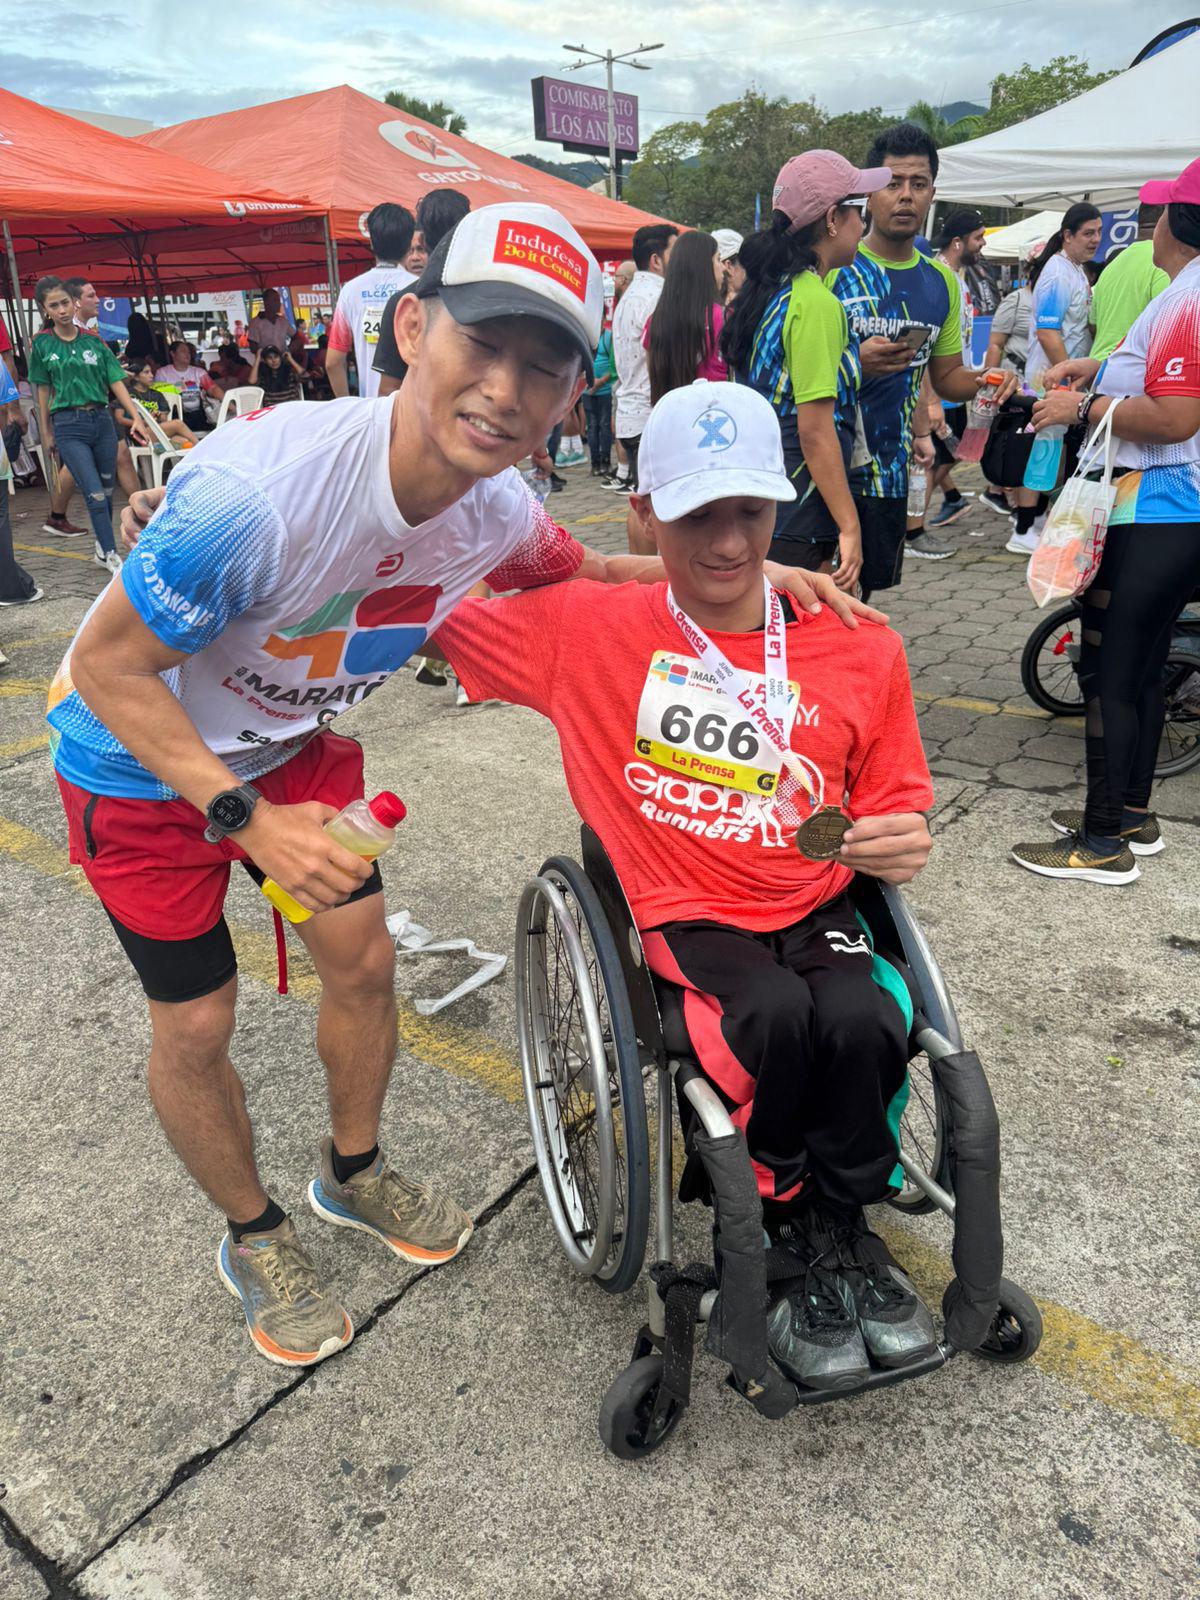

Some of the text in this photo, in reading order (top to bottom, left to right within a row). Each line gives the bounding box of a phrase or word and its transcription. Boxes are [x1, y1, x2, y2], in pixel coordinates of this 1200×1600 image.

[549, 85, 633, 117] COMISARATO
[551, 112, 581, 138] LOS
[505, 228, 583, 276] Indufesa
[528, 249, 537, 263] it
[540, 253, 582, 289] Center
[767, 640, 781, 659] La
[718, 661, 734, 678] JUNIO
[221, 676, 245, 697] La
[660, 704, 759, 761] 666
[737, 689, 755, 710] La
[750, 707, 790, 752] Prensa
[672, 752, 736, 779] La Prensa
[639, 800, 754, 843] Runners
